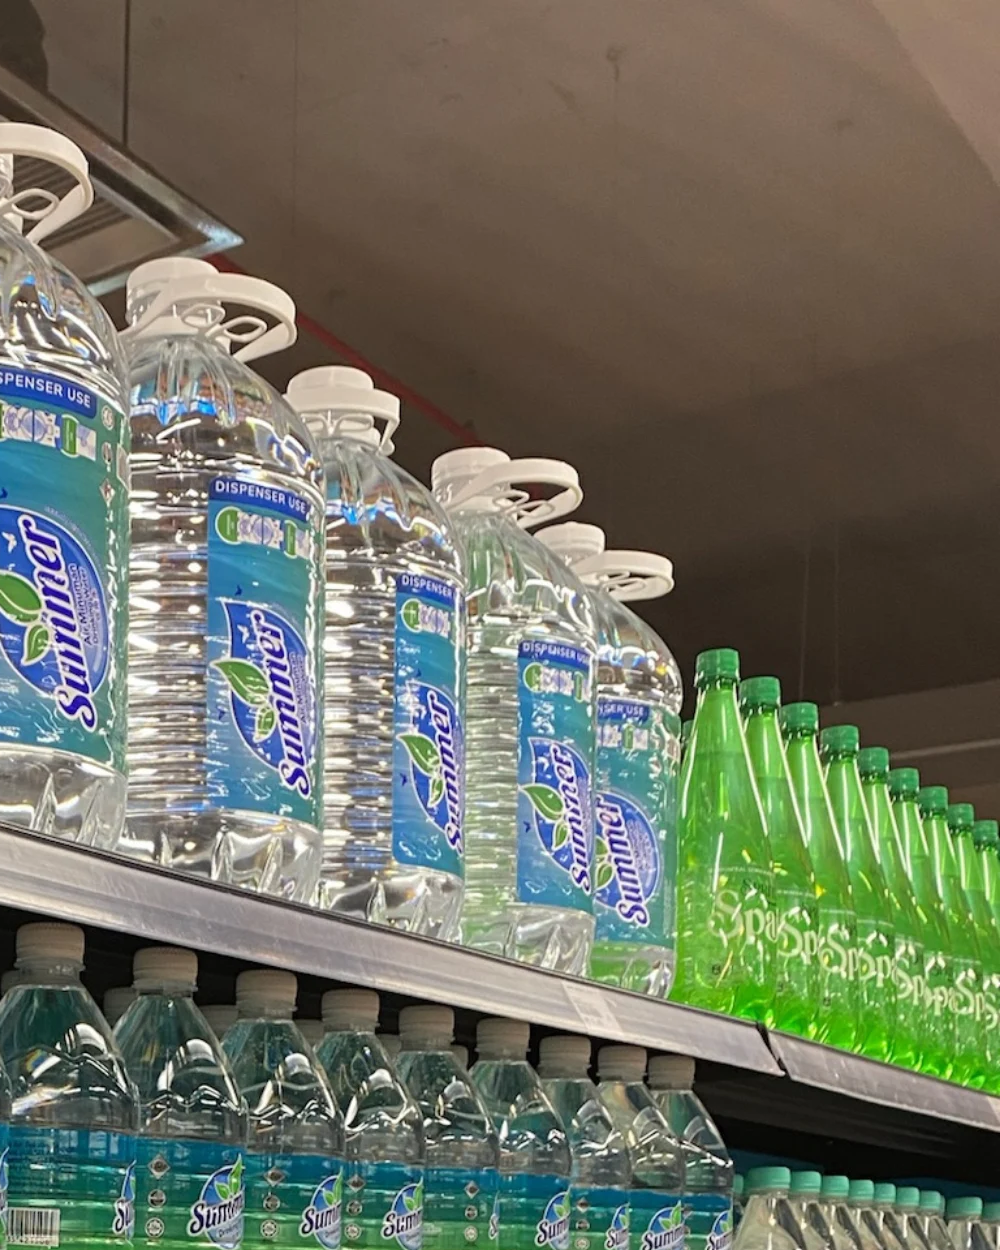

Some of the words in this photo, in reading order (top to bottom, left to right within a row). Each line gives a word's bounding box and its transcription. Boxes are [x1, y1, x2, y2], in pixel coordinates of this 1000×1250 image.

[66, 387, 92, 409] USE
[215, 480, 285, 505] DISPENSER
[288, 497, 307, 514] USE
[20, 516, 97, 731] Summer
[68, 563, 88, 624] Minuman
[401, 574, 453, 599] DISPENSER
[251, 612, 310, 797] Summer
[428, 692, 463, 855] Summer
[551, 746, 591, 892] Summer
[594, 797, 649, 926] Summer
